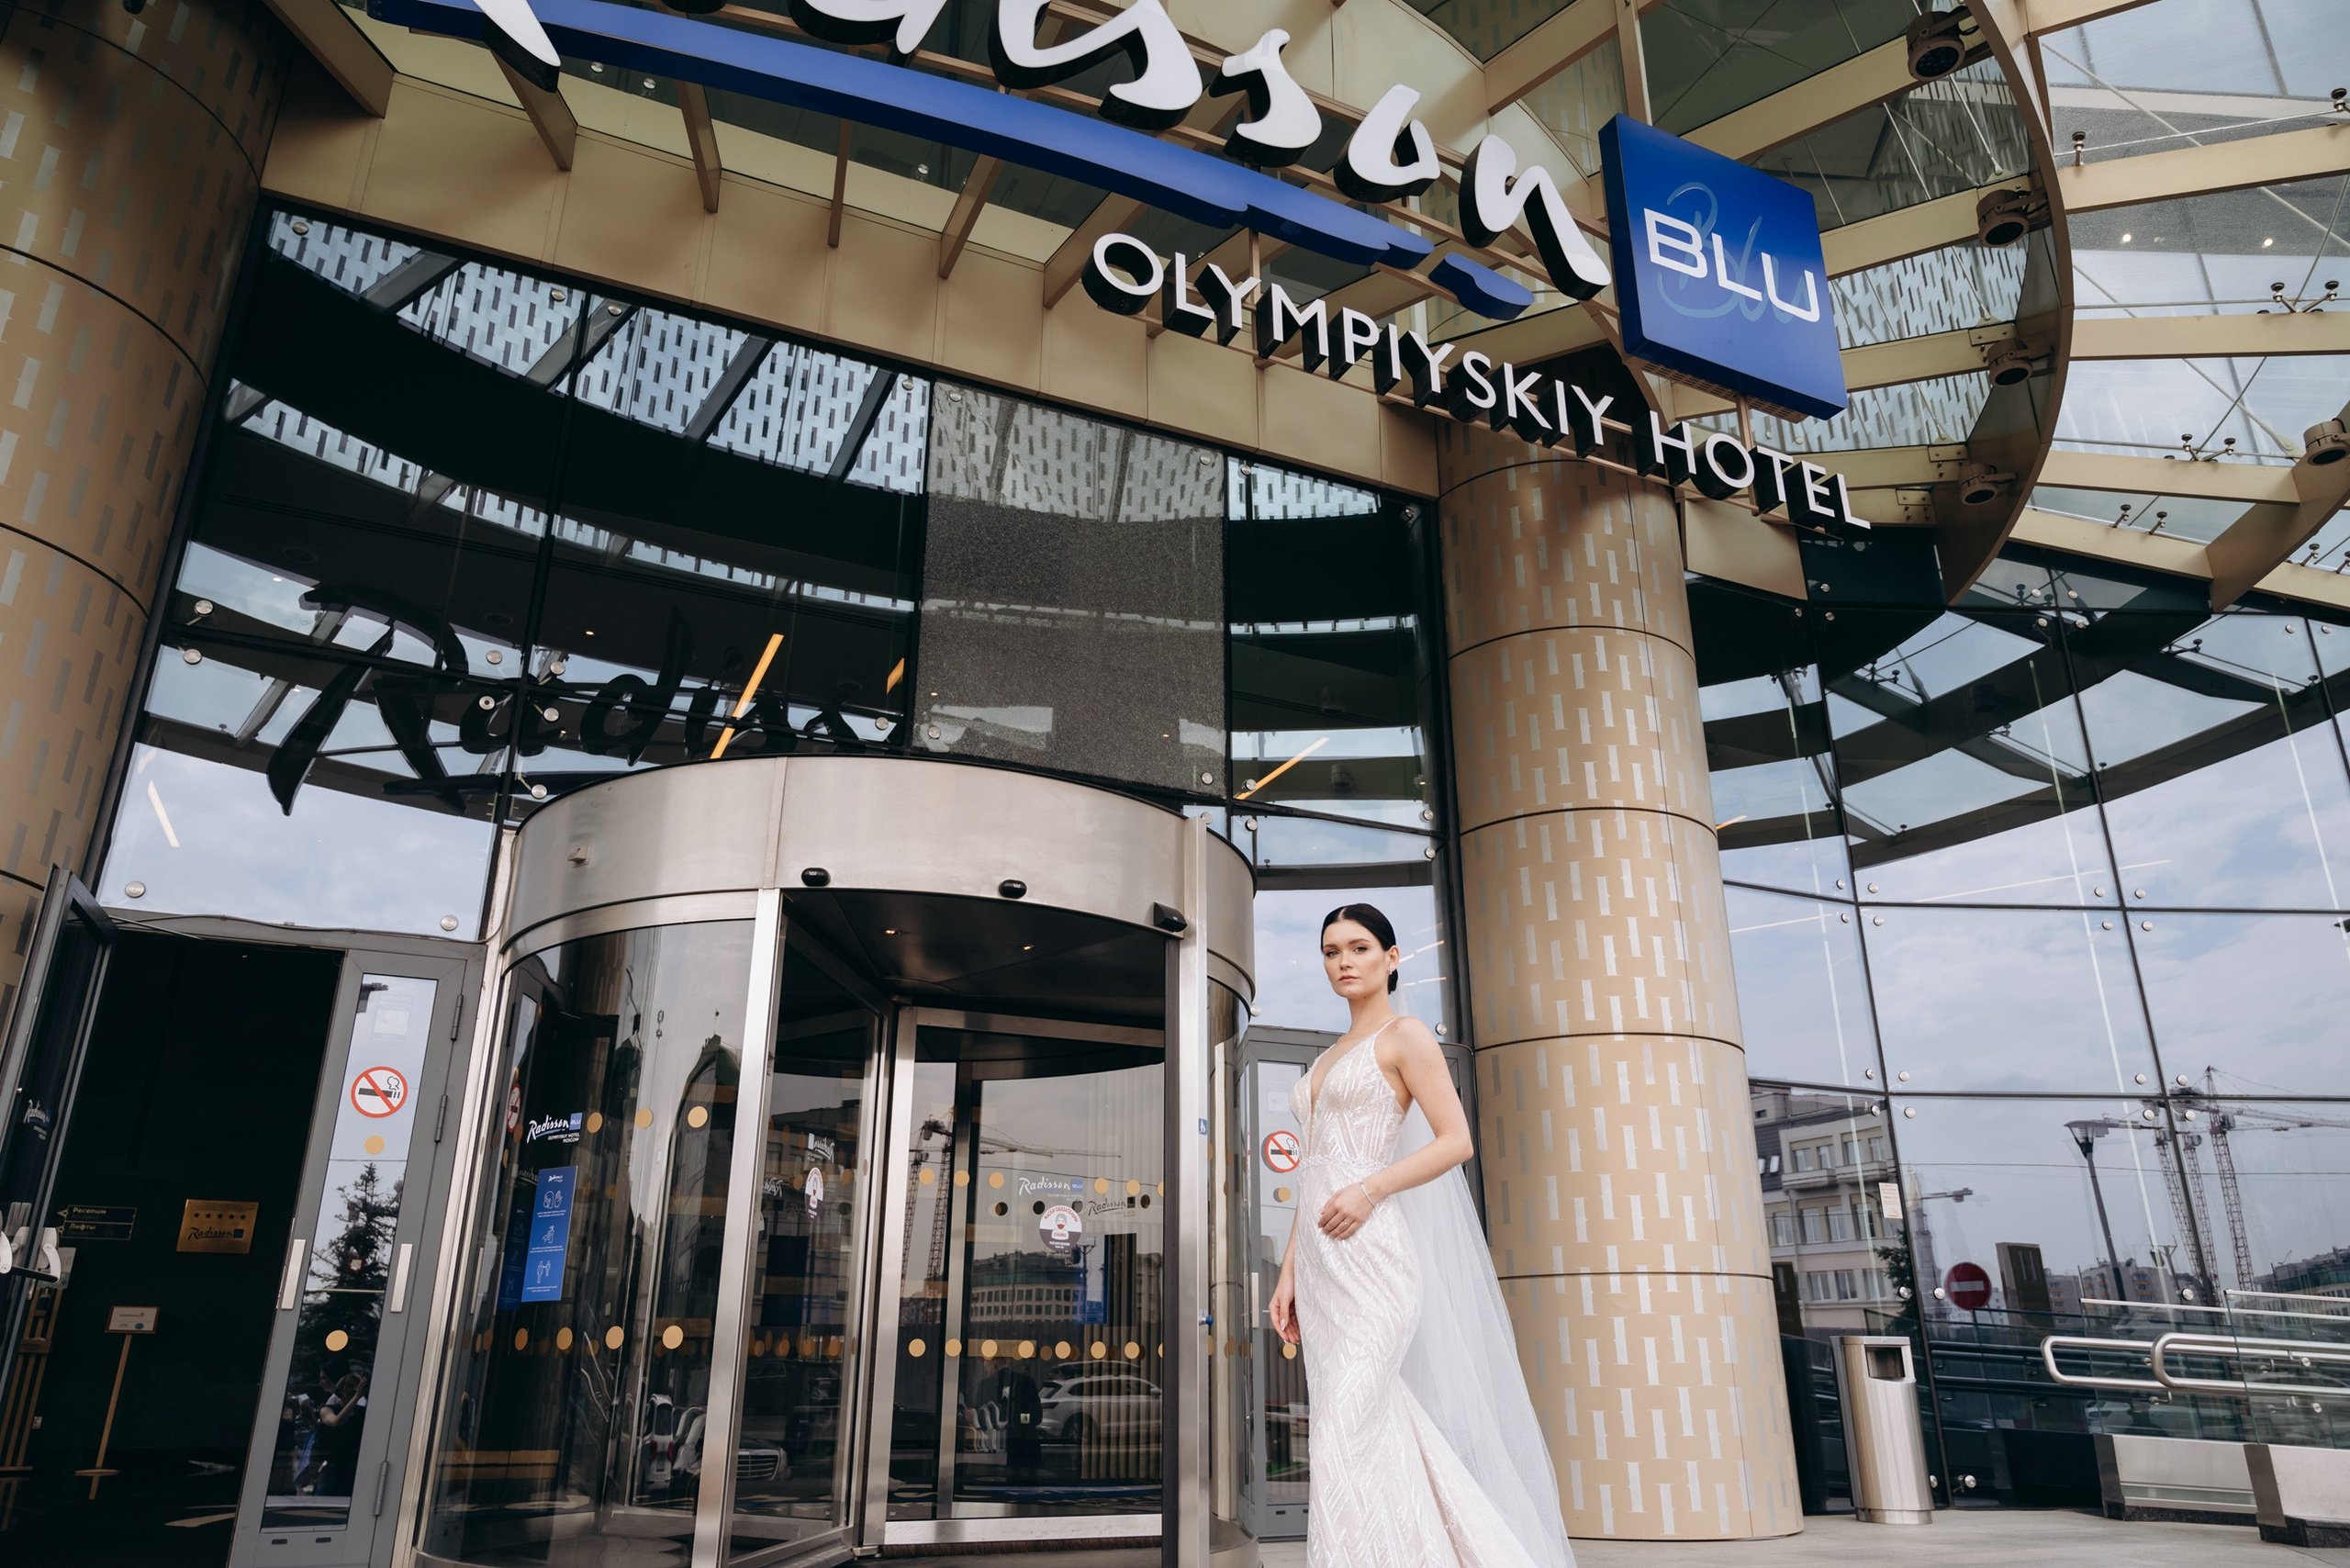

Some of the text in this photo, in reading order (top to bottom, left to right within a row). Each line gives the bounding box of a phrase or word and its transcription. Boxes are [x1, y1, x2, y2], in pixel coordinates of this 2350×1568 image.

[1644, 208, 1820, 322] BLU
[1091, 232, 1872, 530] OLYMPIYSKIY HOTEL
[526, 1114, 569, 1144] Radisson
[1018, 1175, 1071, 1196] Radisson
[73, 1206, 106, 1215] Ресепшн
[69, 1223, 96, 1231] Лифты
[188, 1226, 232, 1240] Radisson
